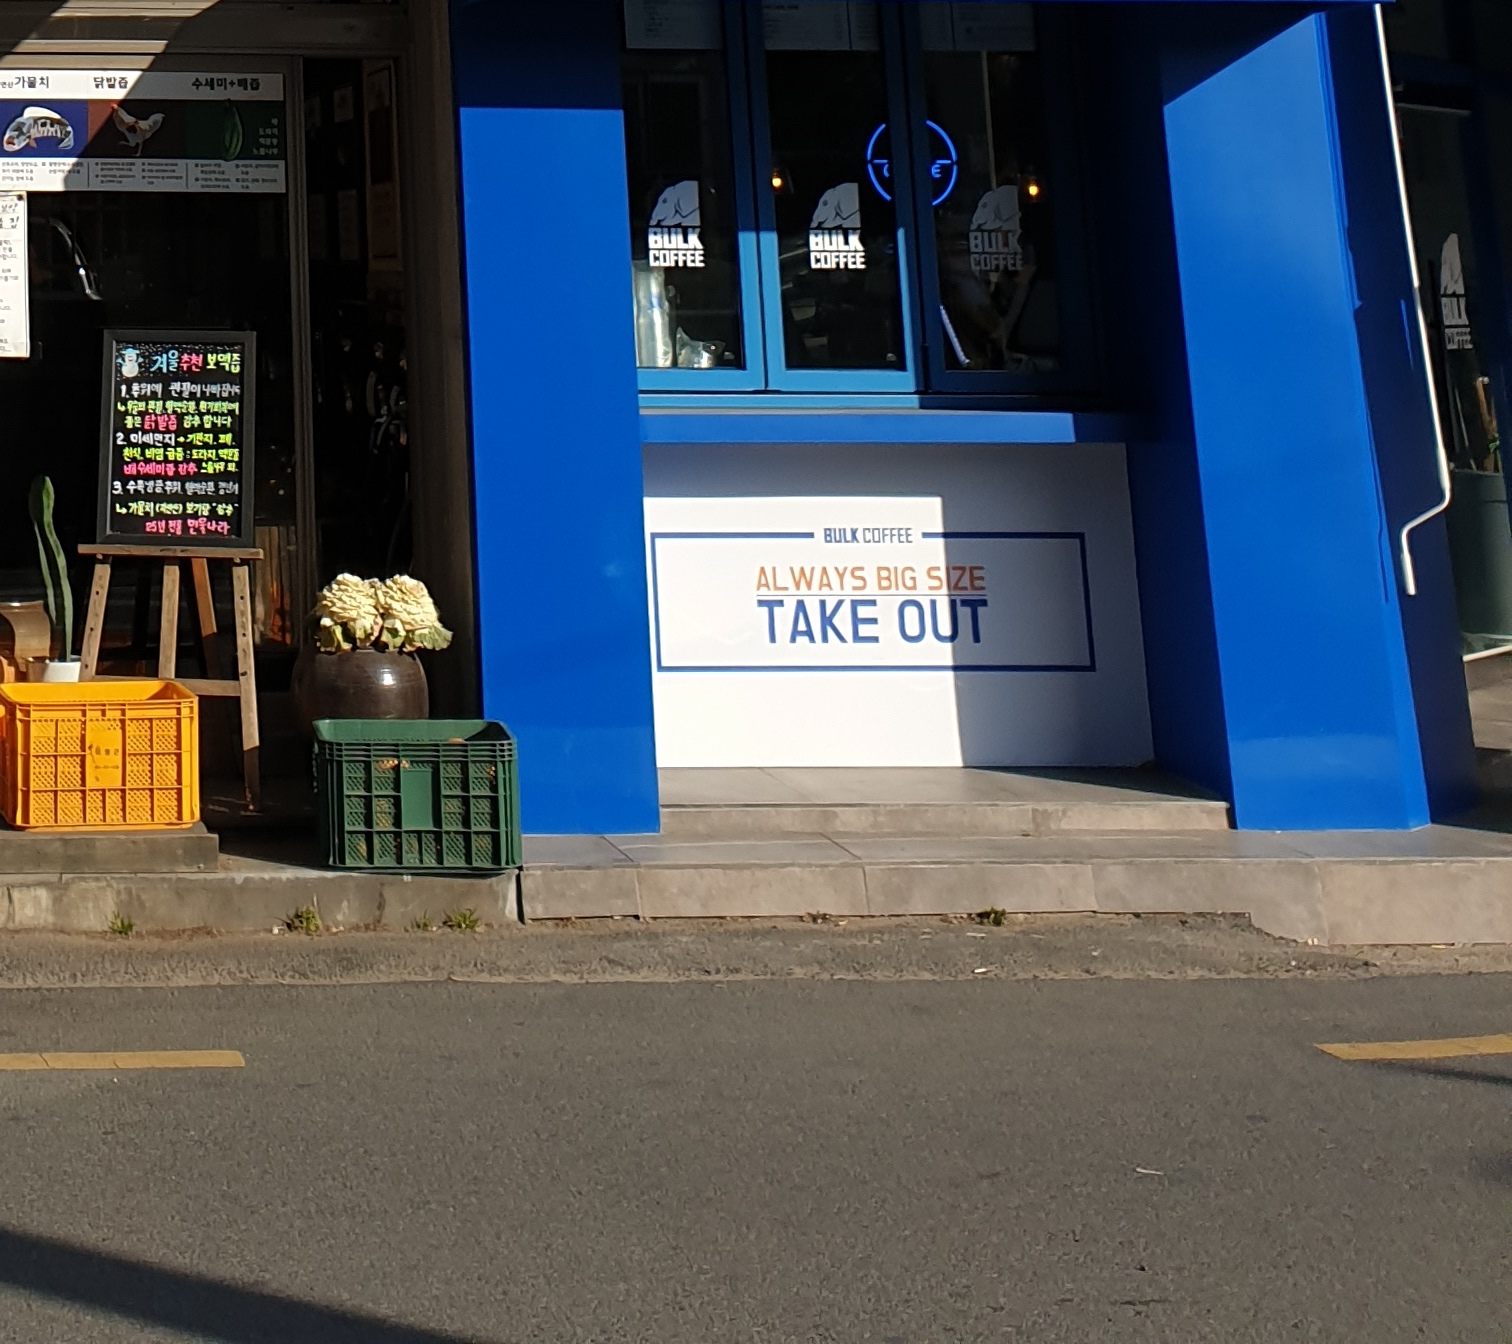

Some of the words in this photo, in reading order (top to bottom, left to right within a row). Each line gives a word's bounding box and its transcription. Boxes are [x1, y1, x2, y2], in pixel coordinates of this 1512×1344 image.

[14, 75, 50, 89] 가물치
[93, 75, 129, 90] 닭발즙
[648, 228, 703, 249] BULK
[809, 230, 865, 251] BULK
[649, 250, 705, 268] COFFEE
[810, 252, 866, 270] COFFEE
[130, 431, 175, 446] 미세먼지
[824, 528, 860, 544] BULK
[863, 528, 913, 544] COFFEE
[756, 566, 867, 592] ALWAYS
[877, 566, 917, 592] BIG
[928, 566, 987, 591] SIZE
[756, 599, 879, 644] TAKE
[898, 599, 988, 644] OUT
